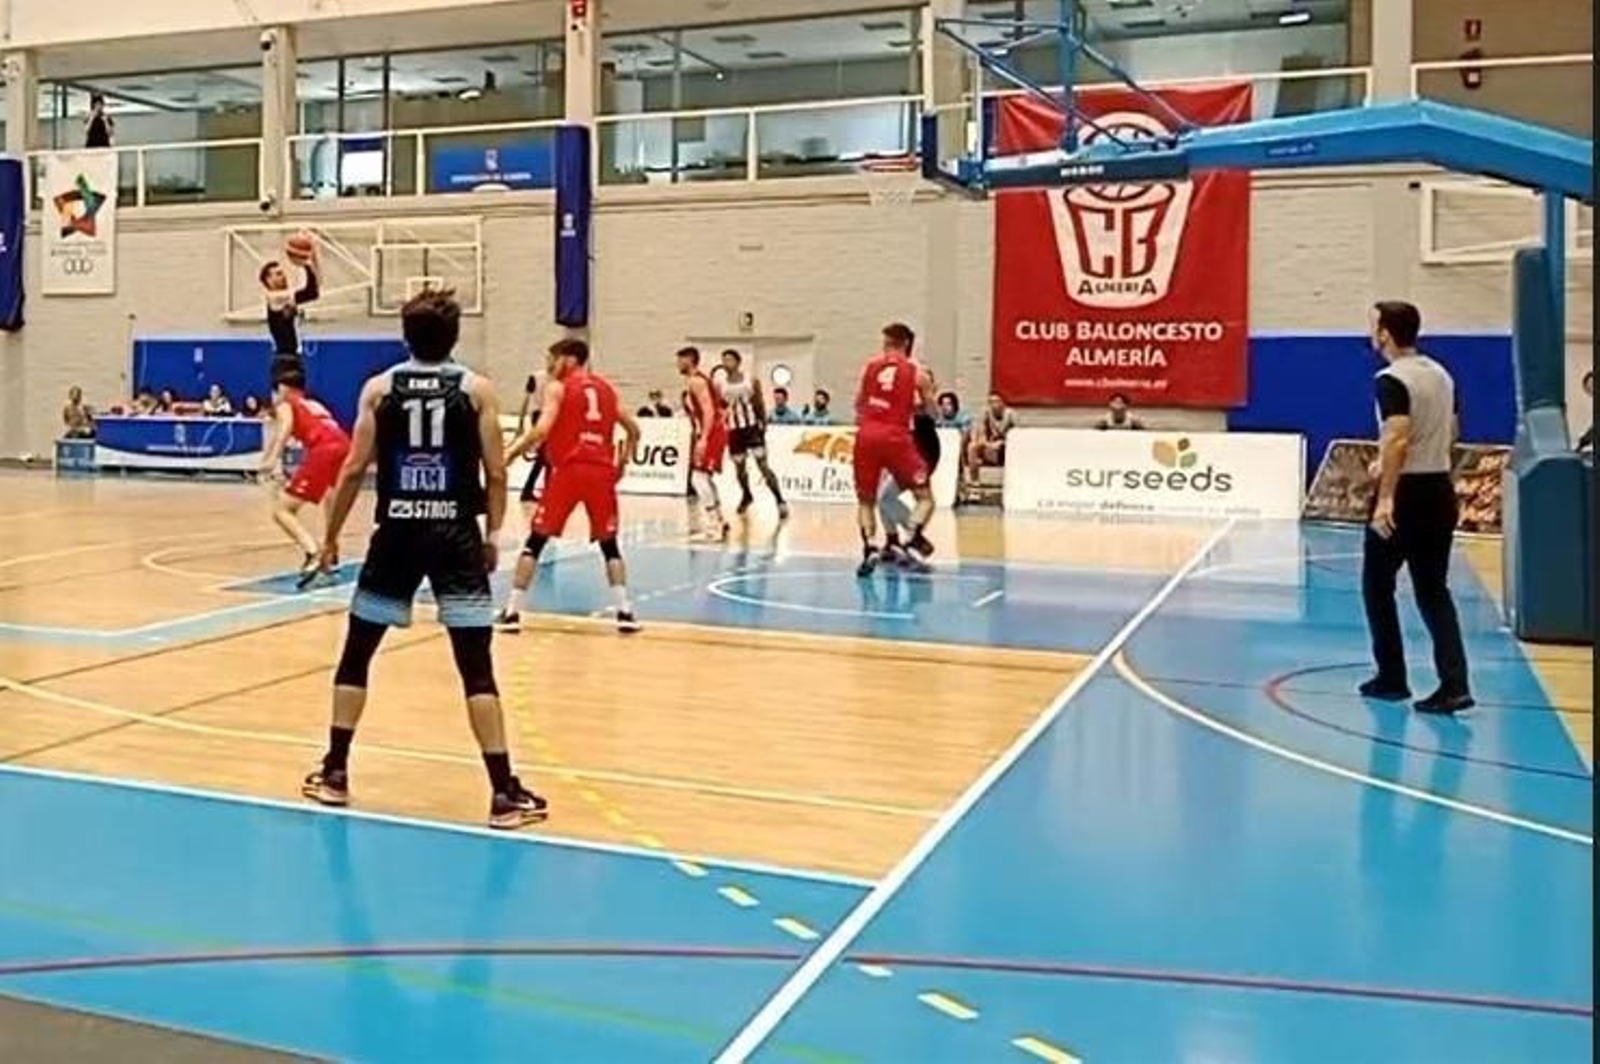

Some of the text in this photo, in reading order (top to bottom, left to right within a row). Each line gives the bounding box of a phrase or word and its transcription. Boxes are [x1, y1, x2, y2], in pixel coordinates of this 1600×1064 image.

[1016, 321, 1223, 341] CLUB BALONCESTO
[1065, 344, 1168, 367] ALMERÍA
[877, 366, 897, 391] 4
[584, 387, 601, 420] 1
[402, 398, 446, 447] 11
[1066, 465, 1233, 492] surseeds
